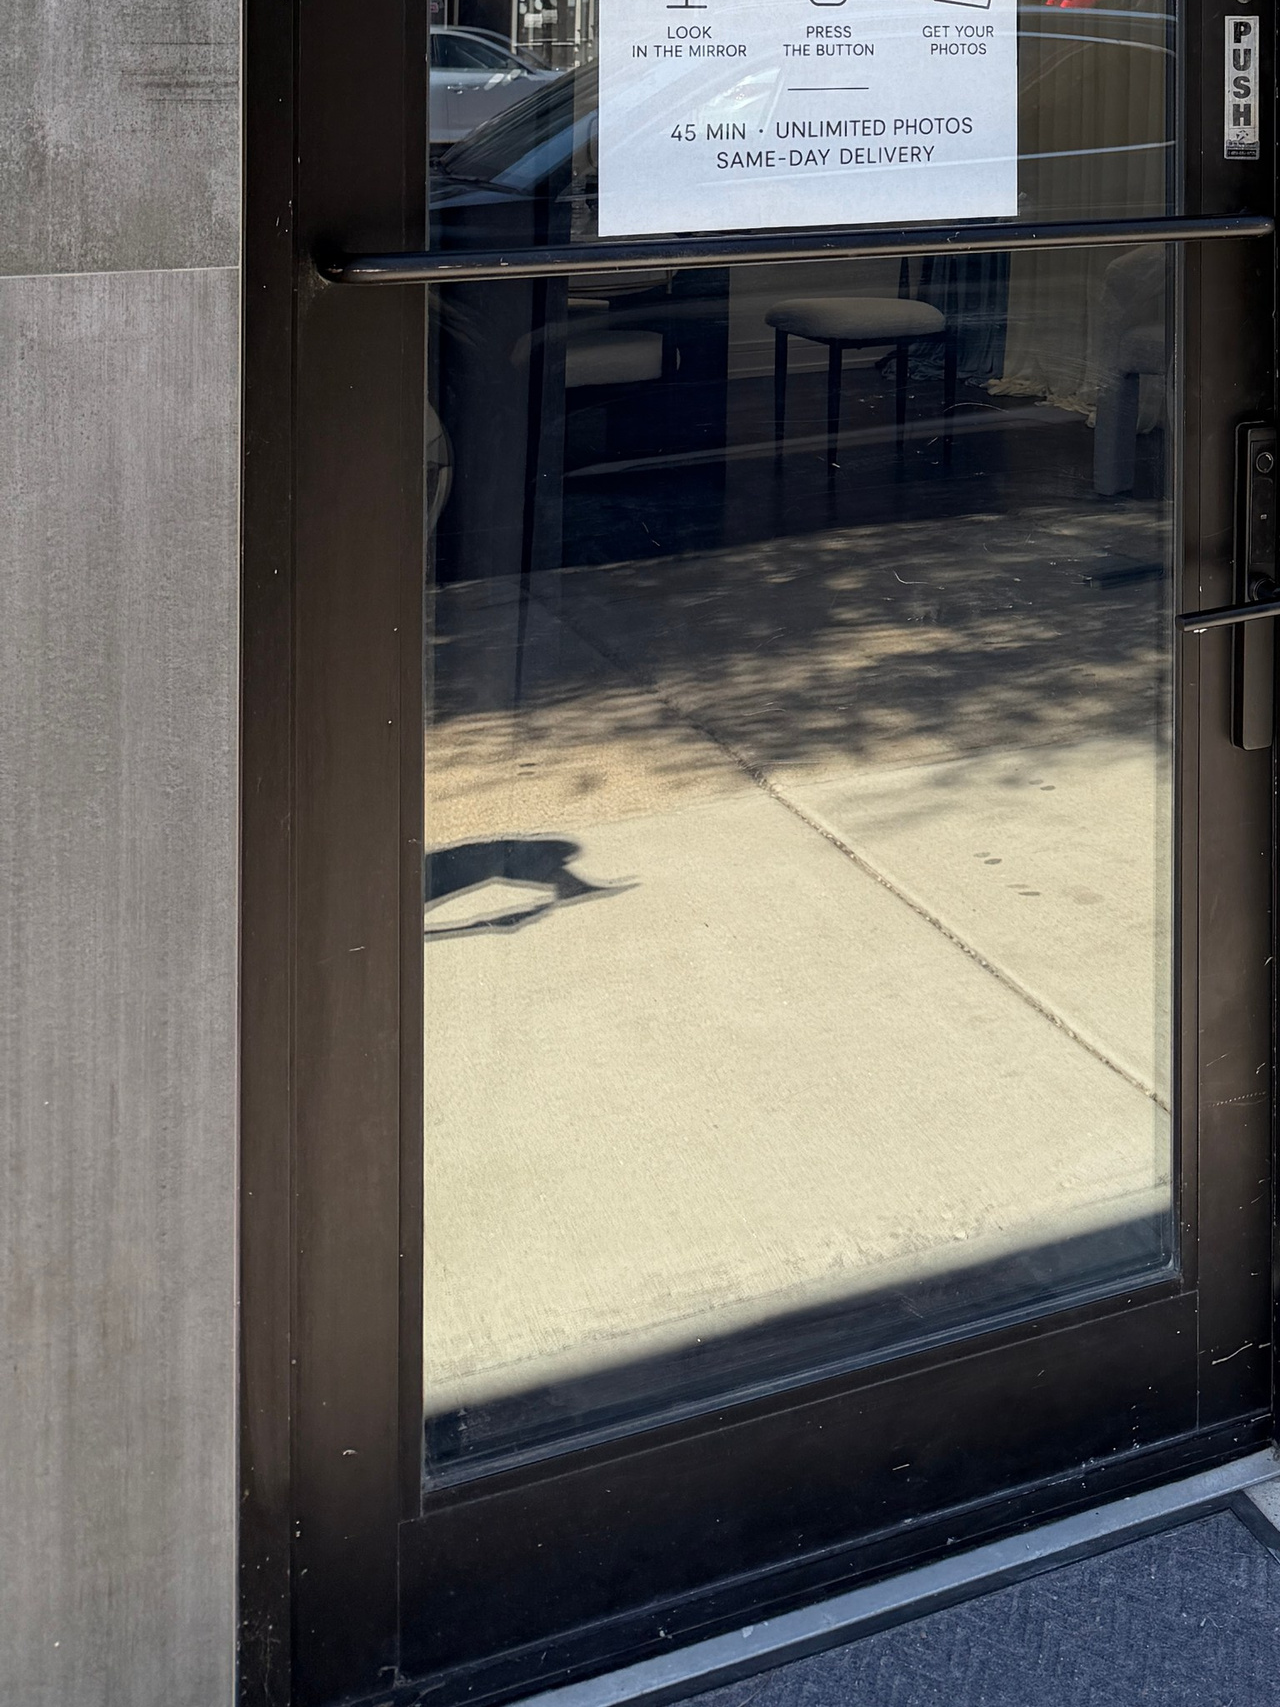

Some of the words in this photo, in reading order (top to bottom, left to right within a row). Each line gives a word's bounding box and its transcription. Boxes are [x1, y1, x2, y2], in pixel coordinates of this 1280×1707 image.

[668, 26, 712, 39] LOOK
[807, 26, 851, 38] PRESS
[923, 25, 952, 38] GET
[955, 26, 993, 37] YOUR
[633, 45, 647, 57] IN
[654, 45, 682, 57] THE
[689, 45, 746, 57] MIRROR
[783, 44, 810, 56] THE
[817, 44, 874, 56] BUTTON
[931, 43, 986, 55] PHOTOS
[1232, 21, 1252, 127] PUSH
[671, 124, 696, 141] 45
[707, 123, 745, 140] MIN
[777, 120, 885, 138] UNLIMITED
[894, 117, 972, 135] PHOTOS
[717, 149, 830, 169] SAME-DAY
[840, 146, 934, 164] DELIVERY
